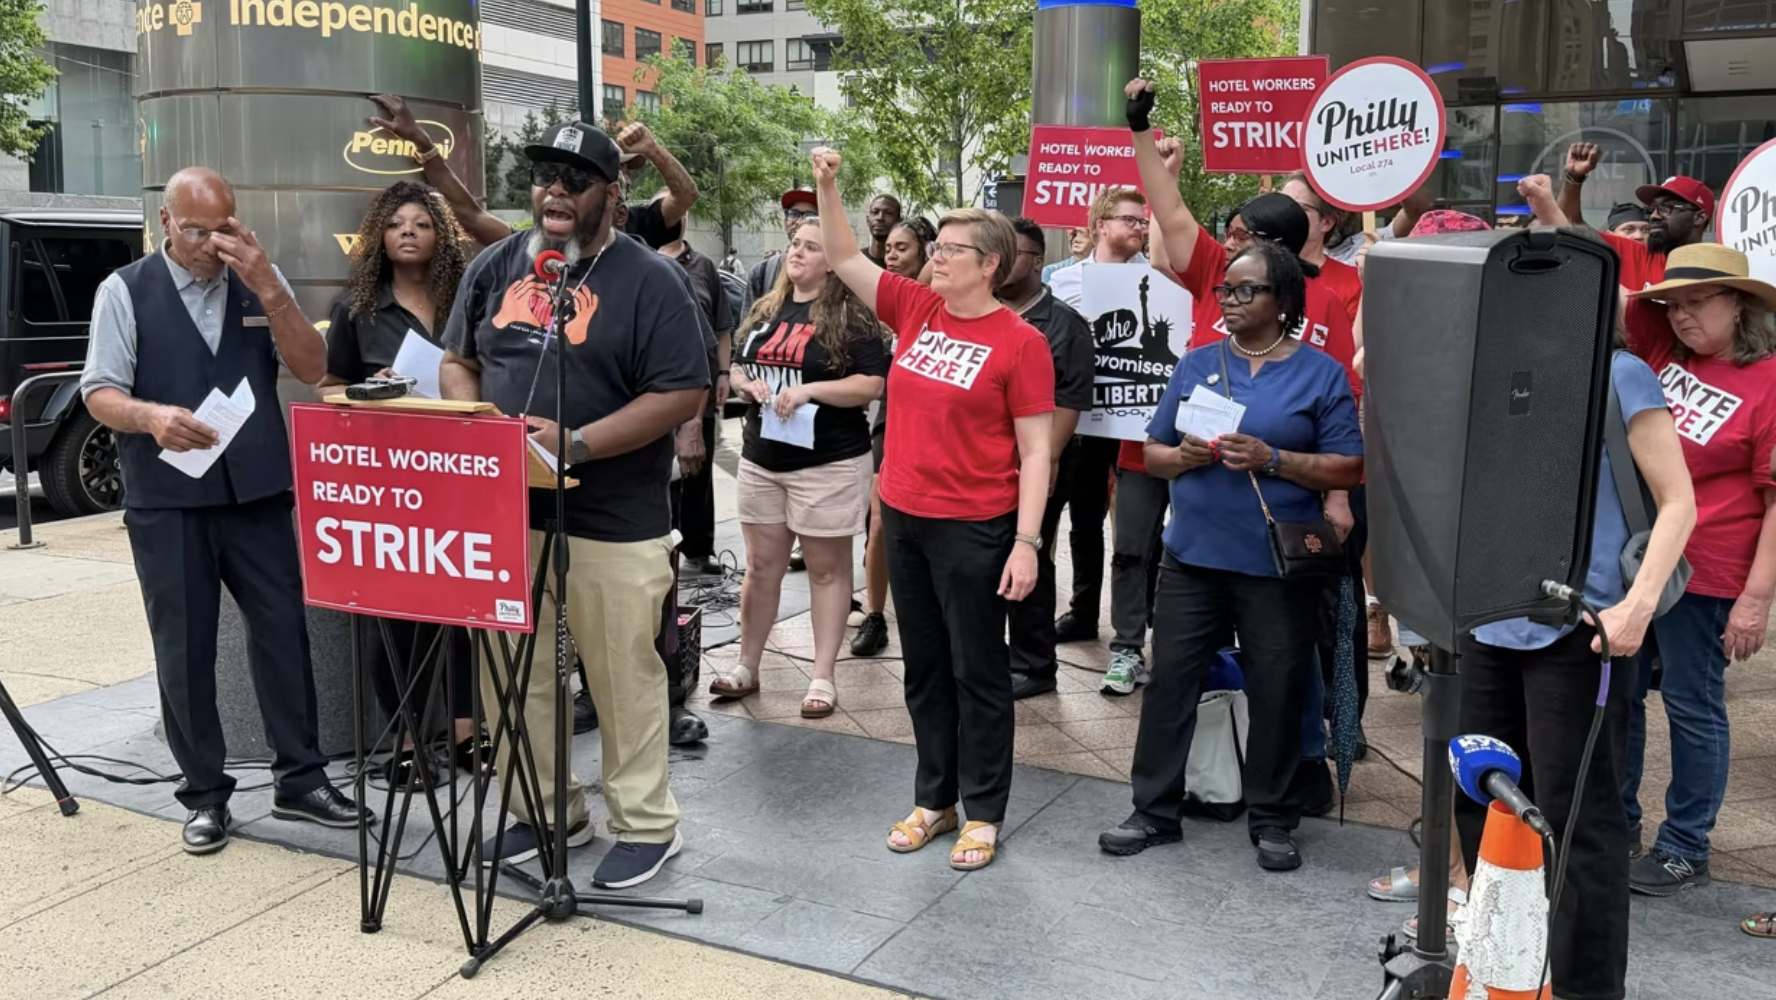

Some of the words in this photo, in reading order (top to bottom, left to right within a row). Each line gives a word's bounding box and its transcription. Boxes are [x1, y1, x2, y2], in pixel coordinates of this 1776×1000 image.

[230, 0, 473, 50] Independence
[1209, 79, 1250, 92] HOTEL
[1252, 78, 1316, 91] WORKERS
[1211, 101, 1252, 114] READY
[1255, 101, 1273, 113] TO
[1317, 97, 1418, 145] Philly
[352, 131, 449, 159] Penni
[1040, 143, 1081, 155] HOTEL
[1085, 144, 1135, 157] WORKE
[1038, 162, 1080, 175] READY
[1083, 164, 1101, 176] TO
[1350, 161, 1375, 174] Local
[1378, 159, 1394, 169] 274
[1034, 180, 1137, 207] STRI
[1102, 311, 1133, 343] she
[918, 326, 988, 365] UNITE
[900, 347, 974, 385] HERE!
[1660, 366, 1737, 419] UNITE
[310, 442, 382, 468] HOTEL
[388, 448, 500, 478] WORKERS
[312, 481, 385, 506] READY
[391, 488, 423, 510] TO
[315, 516, 511, 583] STRIKE.
